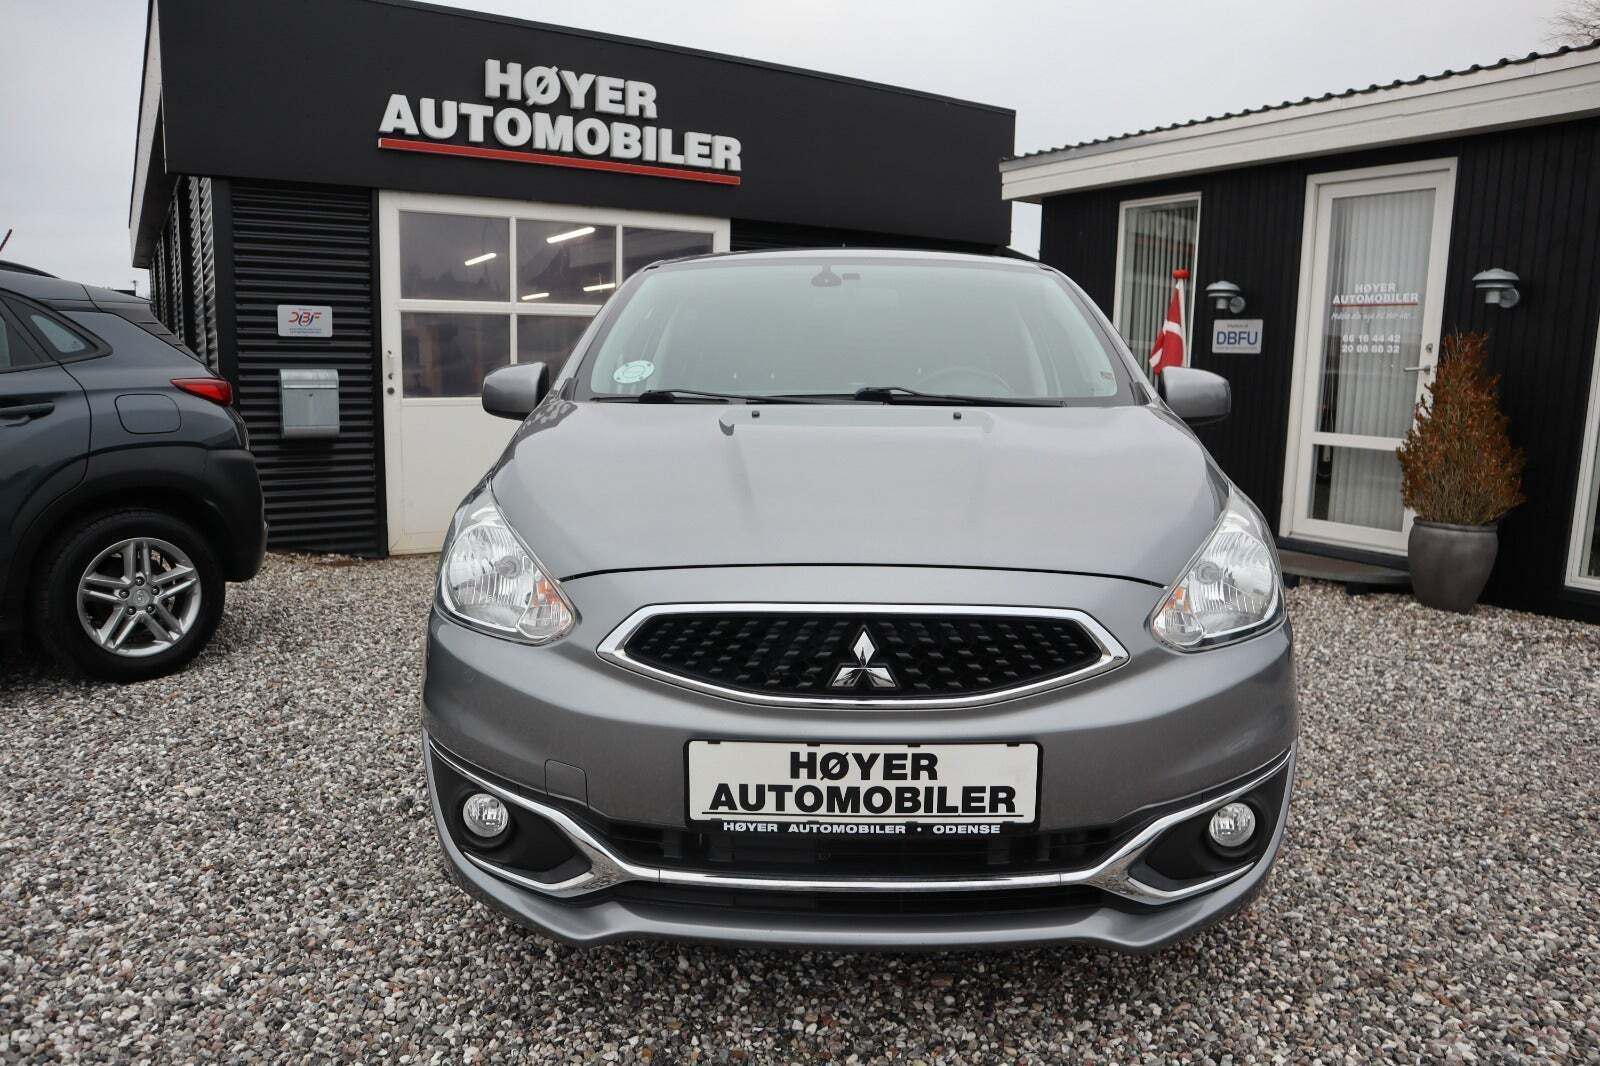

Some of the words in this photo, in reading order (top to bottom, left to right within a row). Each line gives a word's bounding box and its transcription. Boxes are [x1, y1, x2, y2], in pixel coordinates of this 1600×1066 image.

[484, 58, 658, 119] HØYER
[378, 93, 742, 171] AUTOMOBILER
[1333, 293, 1418, 304] AUTOMOBILER
[1216, 331, 1258, 346] DBFU
[790, 751, 939, 781] HØYER
[709, 783, 1017, 814] AUTOMOBILER
[723, 821, 778, 833] HØYER
[788, 823, 906, 835] AUTOMOBILER
[932, 824, 1001, 834] ODENSE
